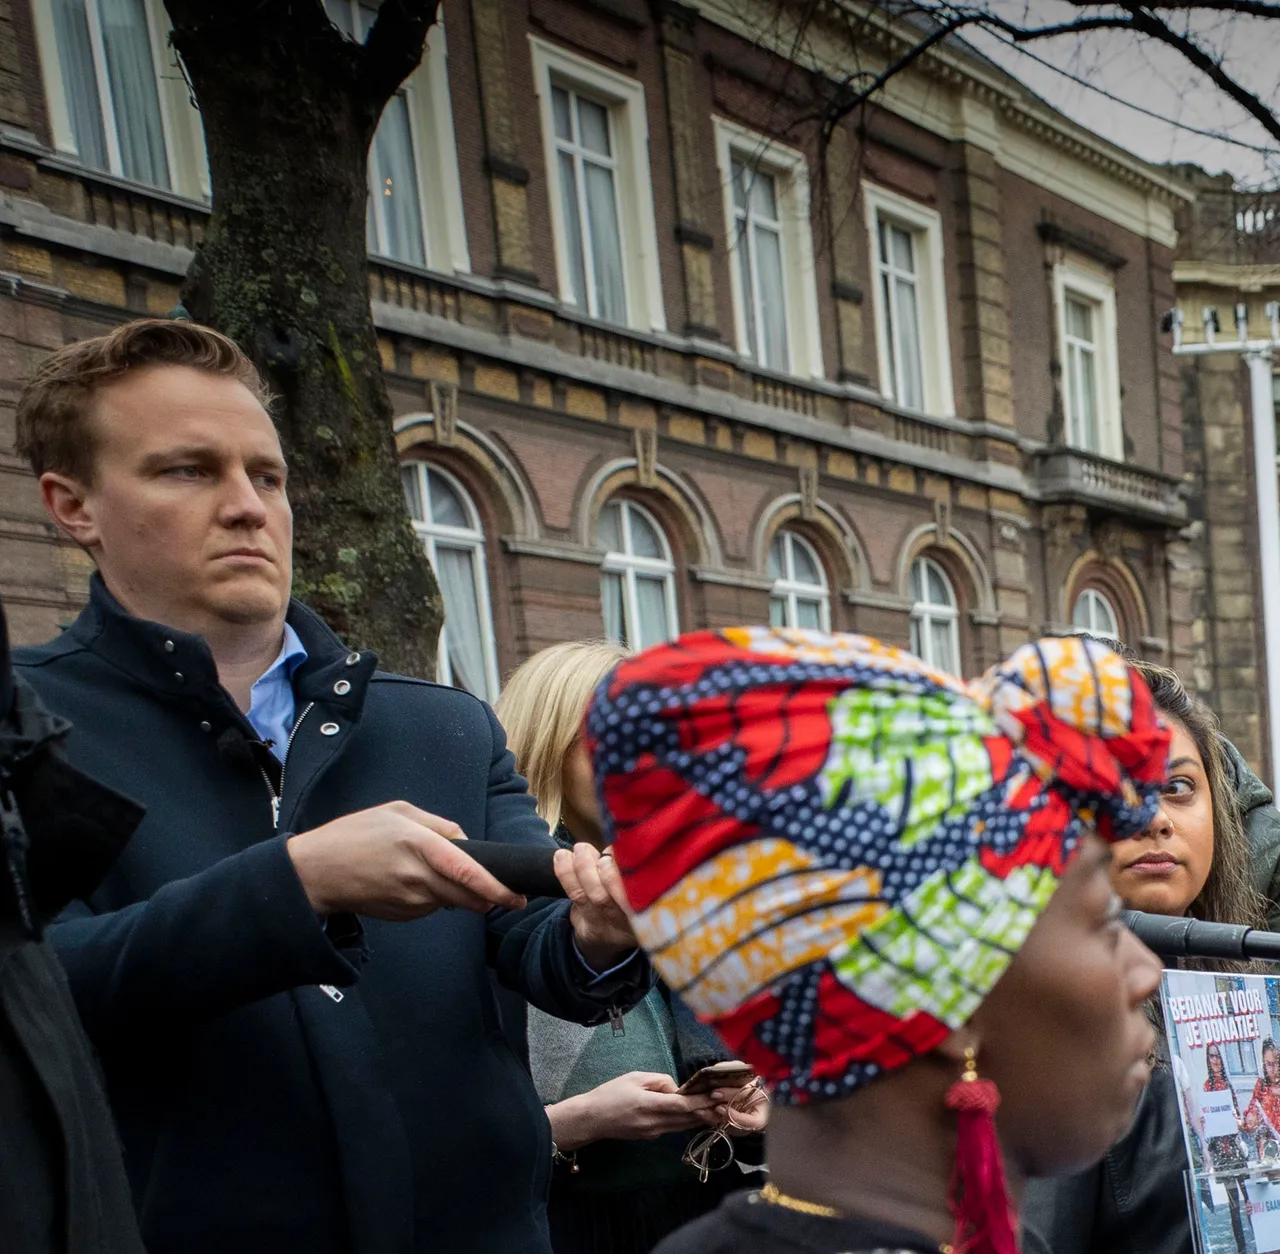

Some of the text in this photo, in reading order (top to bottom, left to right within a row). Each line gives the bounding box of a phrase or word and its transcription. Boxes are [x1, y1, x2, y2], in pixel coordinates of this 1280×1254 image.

[1169, 988, 1264, 1024] BEDANKT VOOR
[1186, 1014, 1261, 1049] JE DONATIE!
